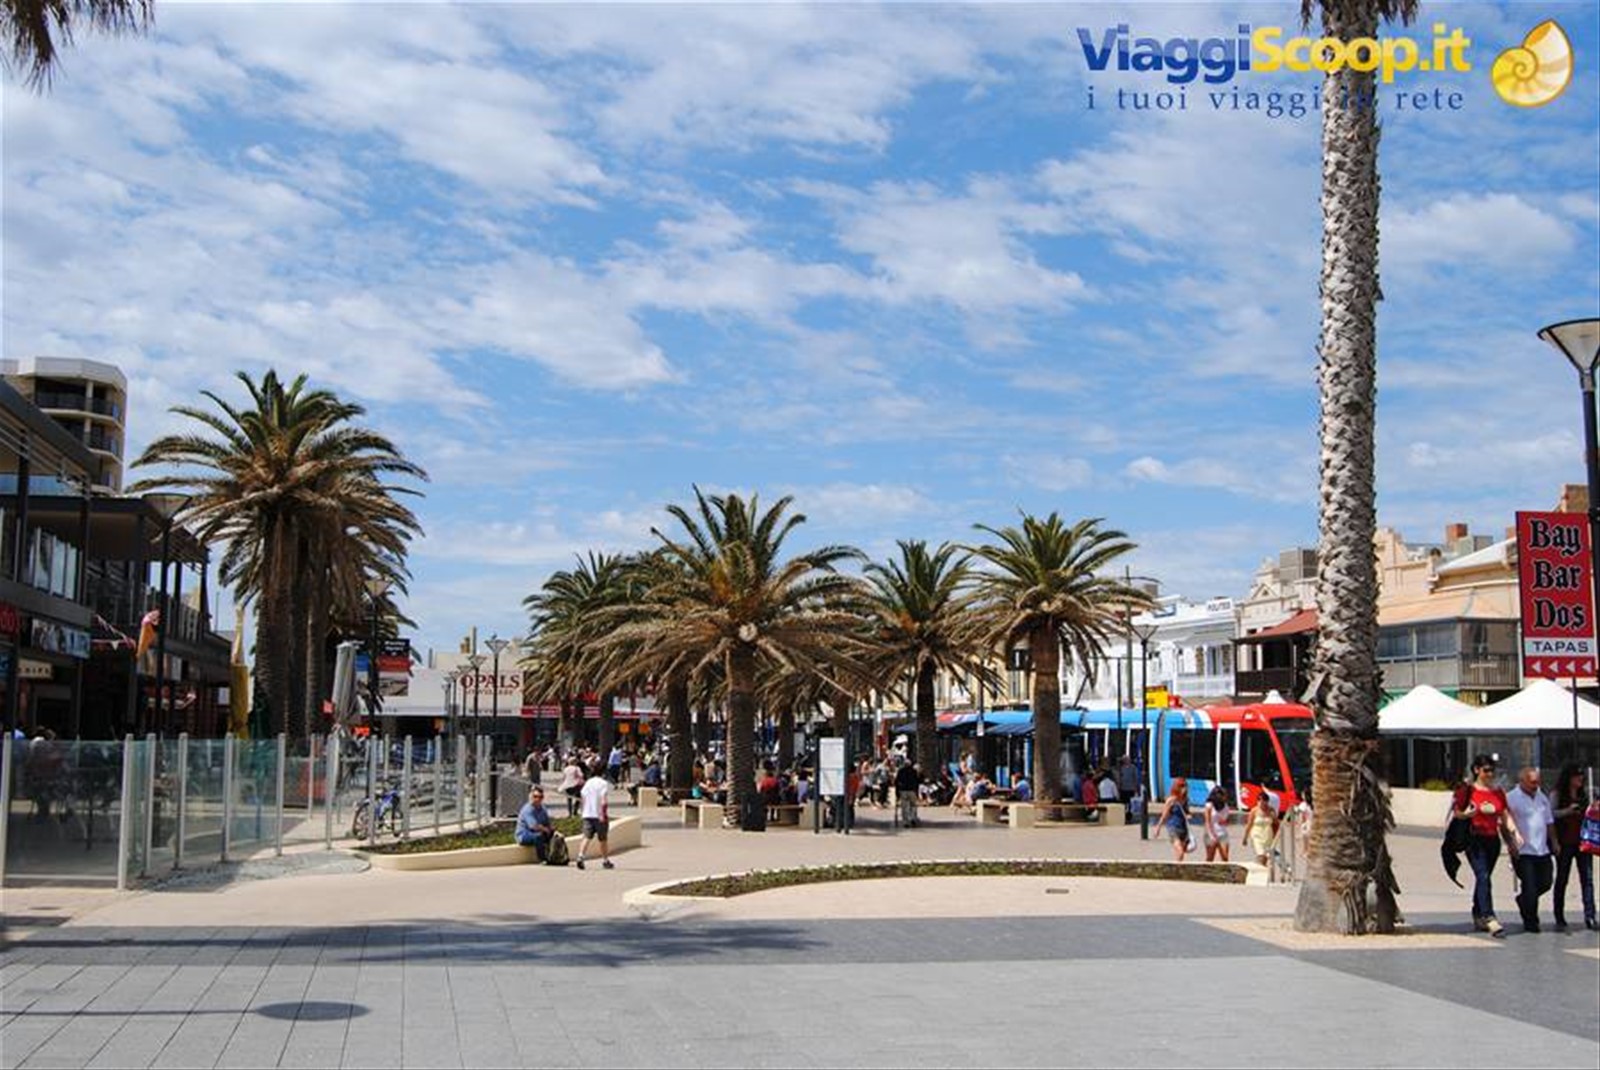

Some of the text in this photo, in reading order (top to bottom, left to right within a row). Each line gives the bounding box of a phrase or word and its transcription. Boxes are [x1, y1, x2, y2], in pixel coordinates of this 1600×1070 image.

[1529, 518, 1582, 557] Bay
[1532, 560, 1582, 590] Bar
[1533, 598, 1587, 630] Dos
[1532, 641, 1589, 653] TAPAS
[460, 673, 520, 689] OPALS
